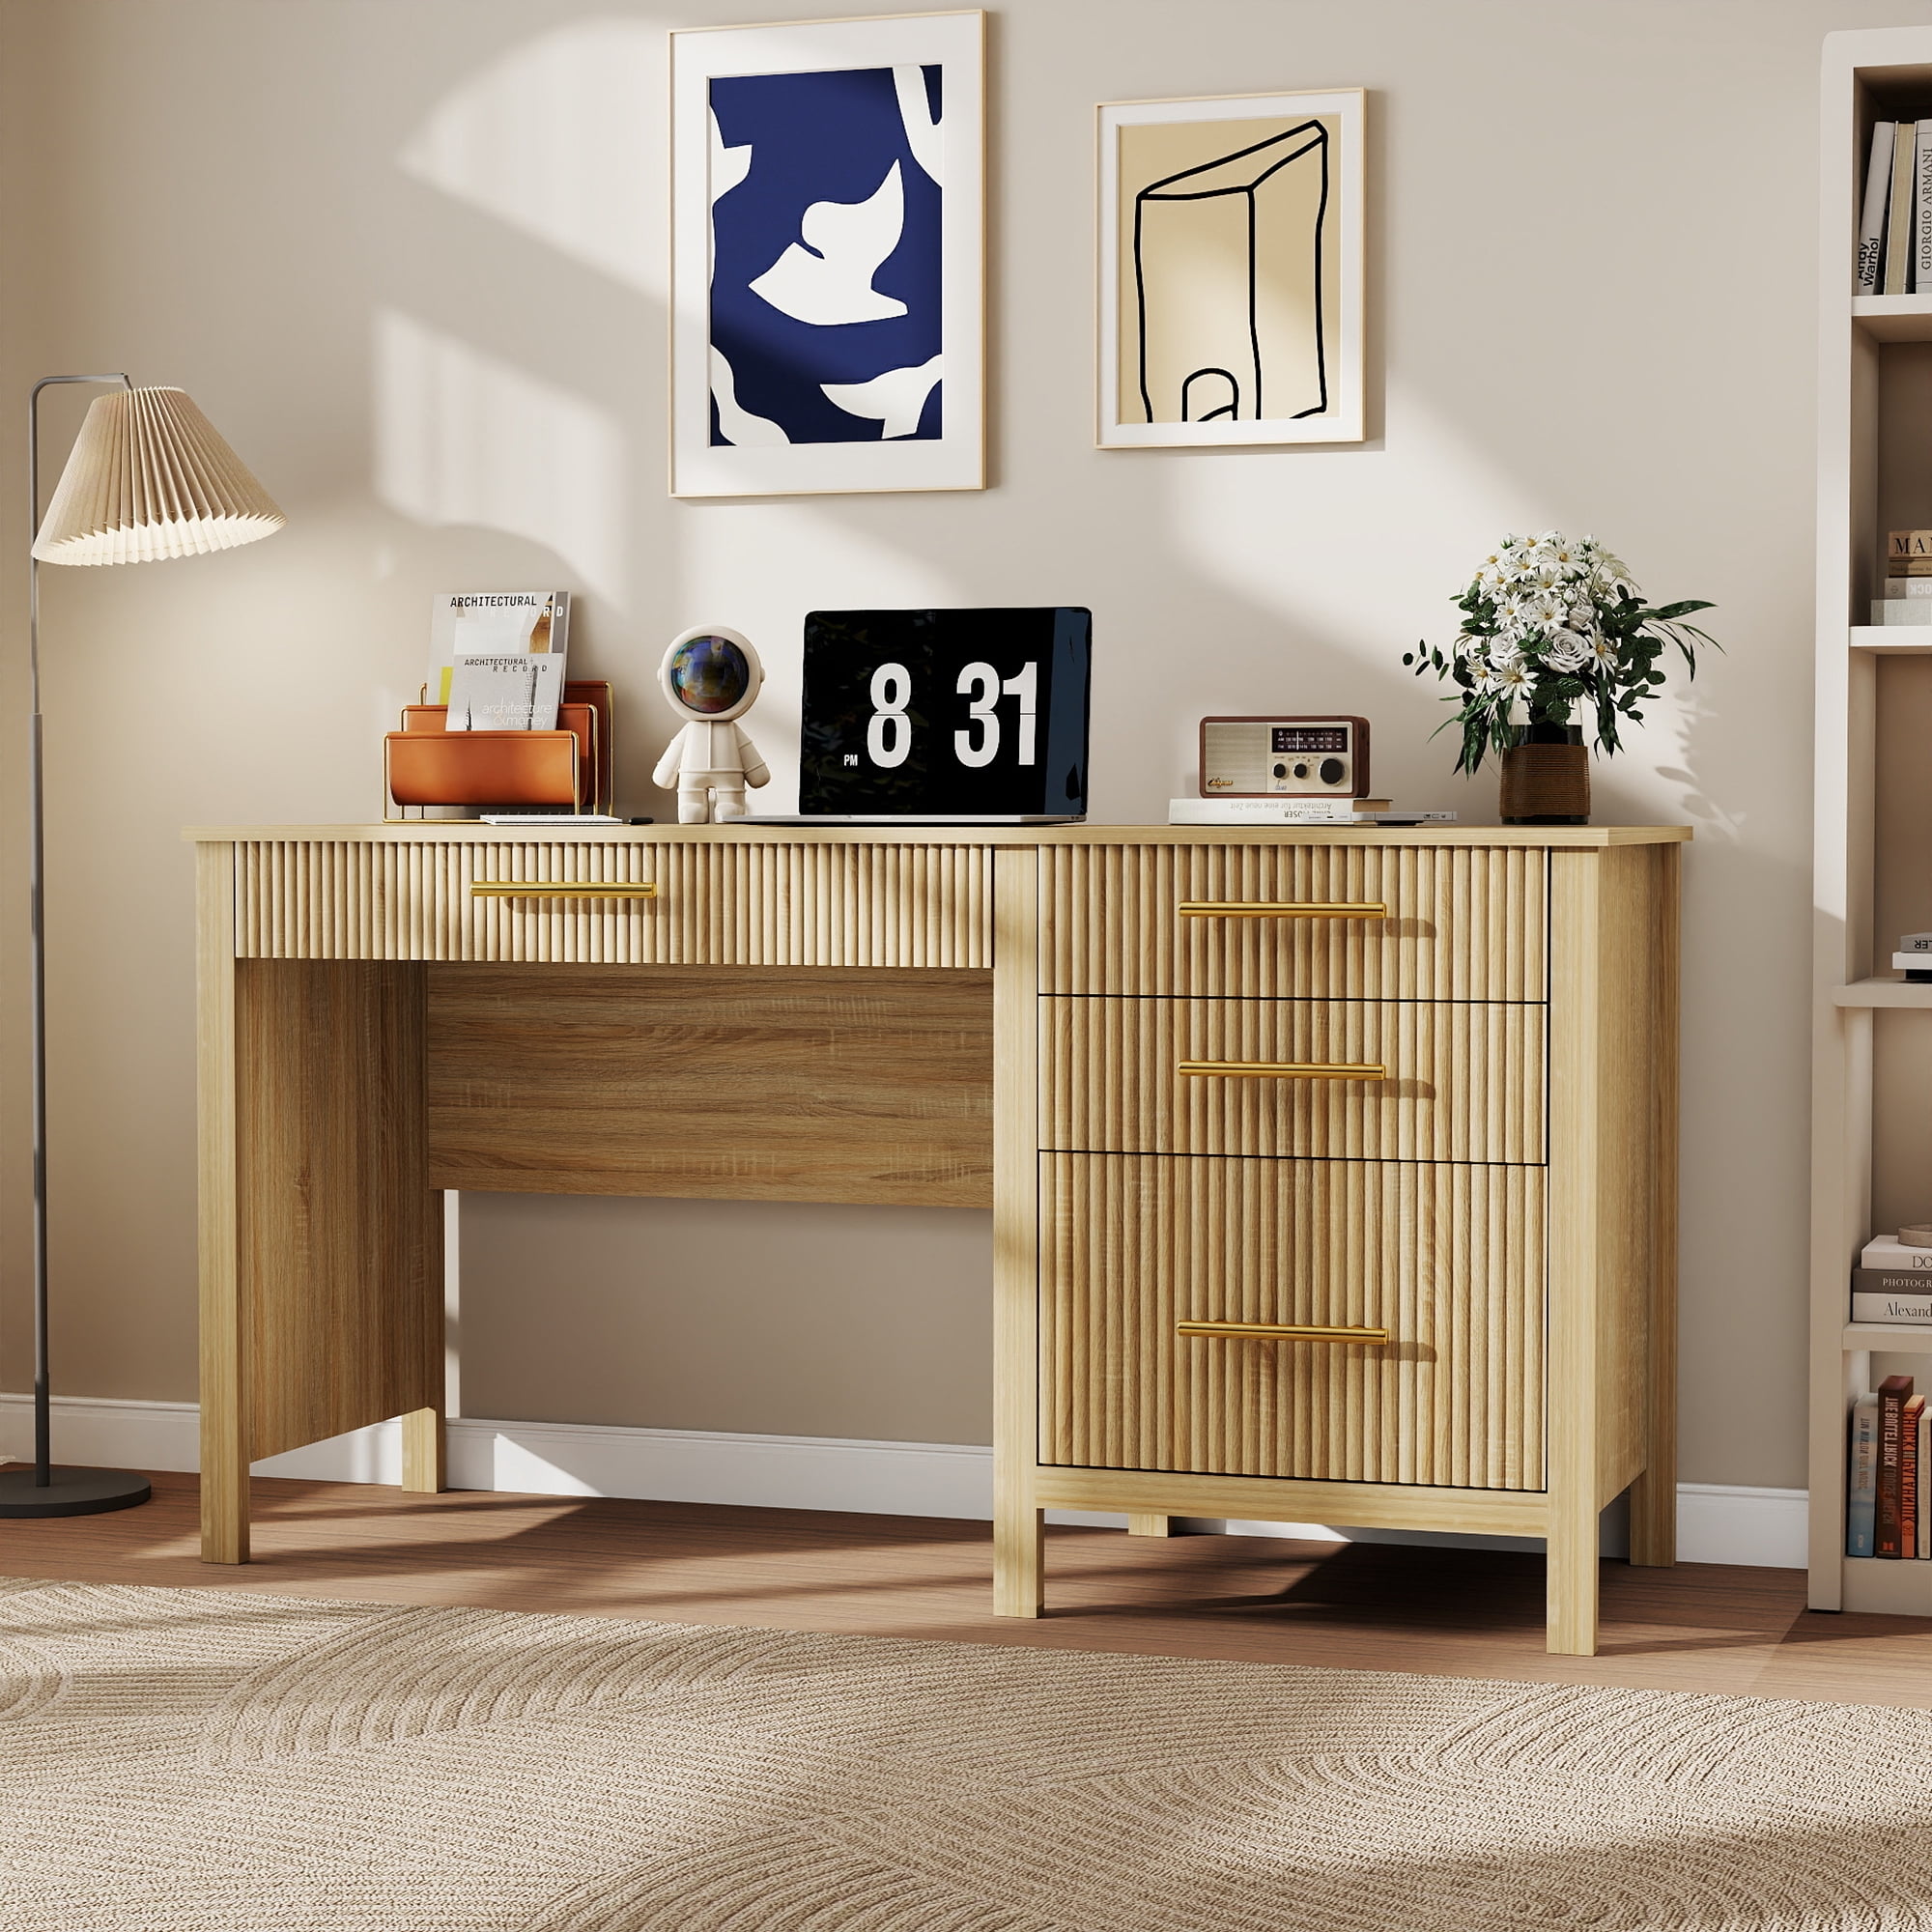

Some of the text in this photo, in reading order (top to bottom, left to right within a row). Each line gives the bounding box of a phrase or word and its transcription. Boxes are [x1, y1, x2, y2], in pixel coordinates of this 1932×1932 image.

[1921, 148, 1932, 270] GIORGIO ARMANI
[1863, 238, 1880, 287] Warhol
[1894, 537, 1932, 554] MA
[450, 595, 537, 608] ARCHITECTURAL
[465, 658, 527, 667] ARCHITECTURAL
[492, 665, 548, 673] RECORD
[867, 662, 1037, 769] 8 31
[843, 754, 859, 767] PM
[1883, 1277, 1932, 1289] PHOTOGR
[1884, 1301, 1932, 1319] Alexand
